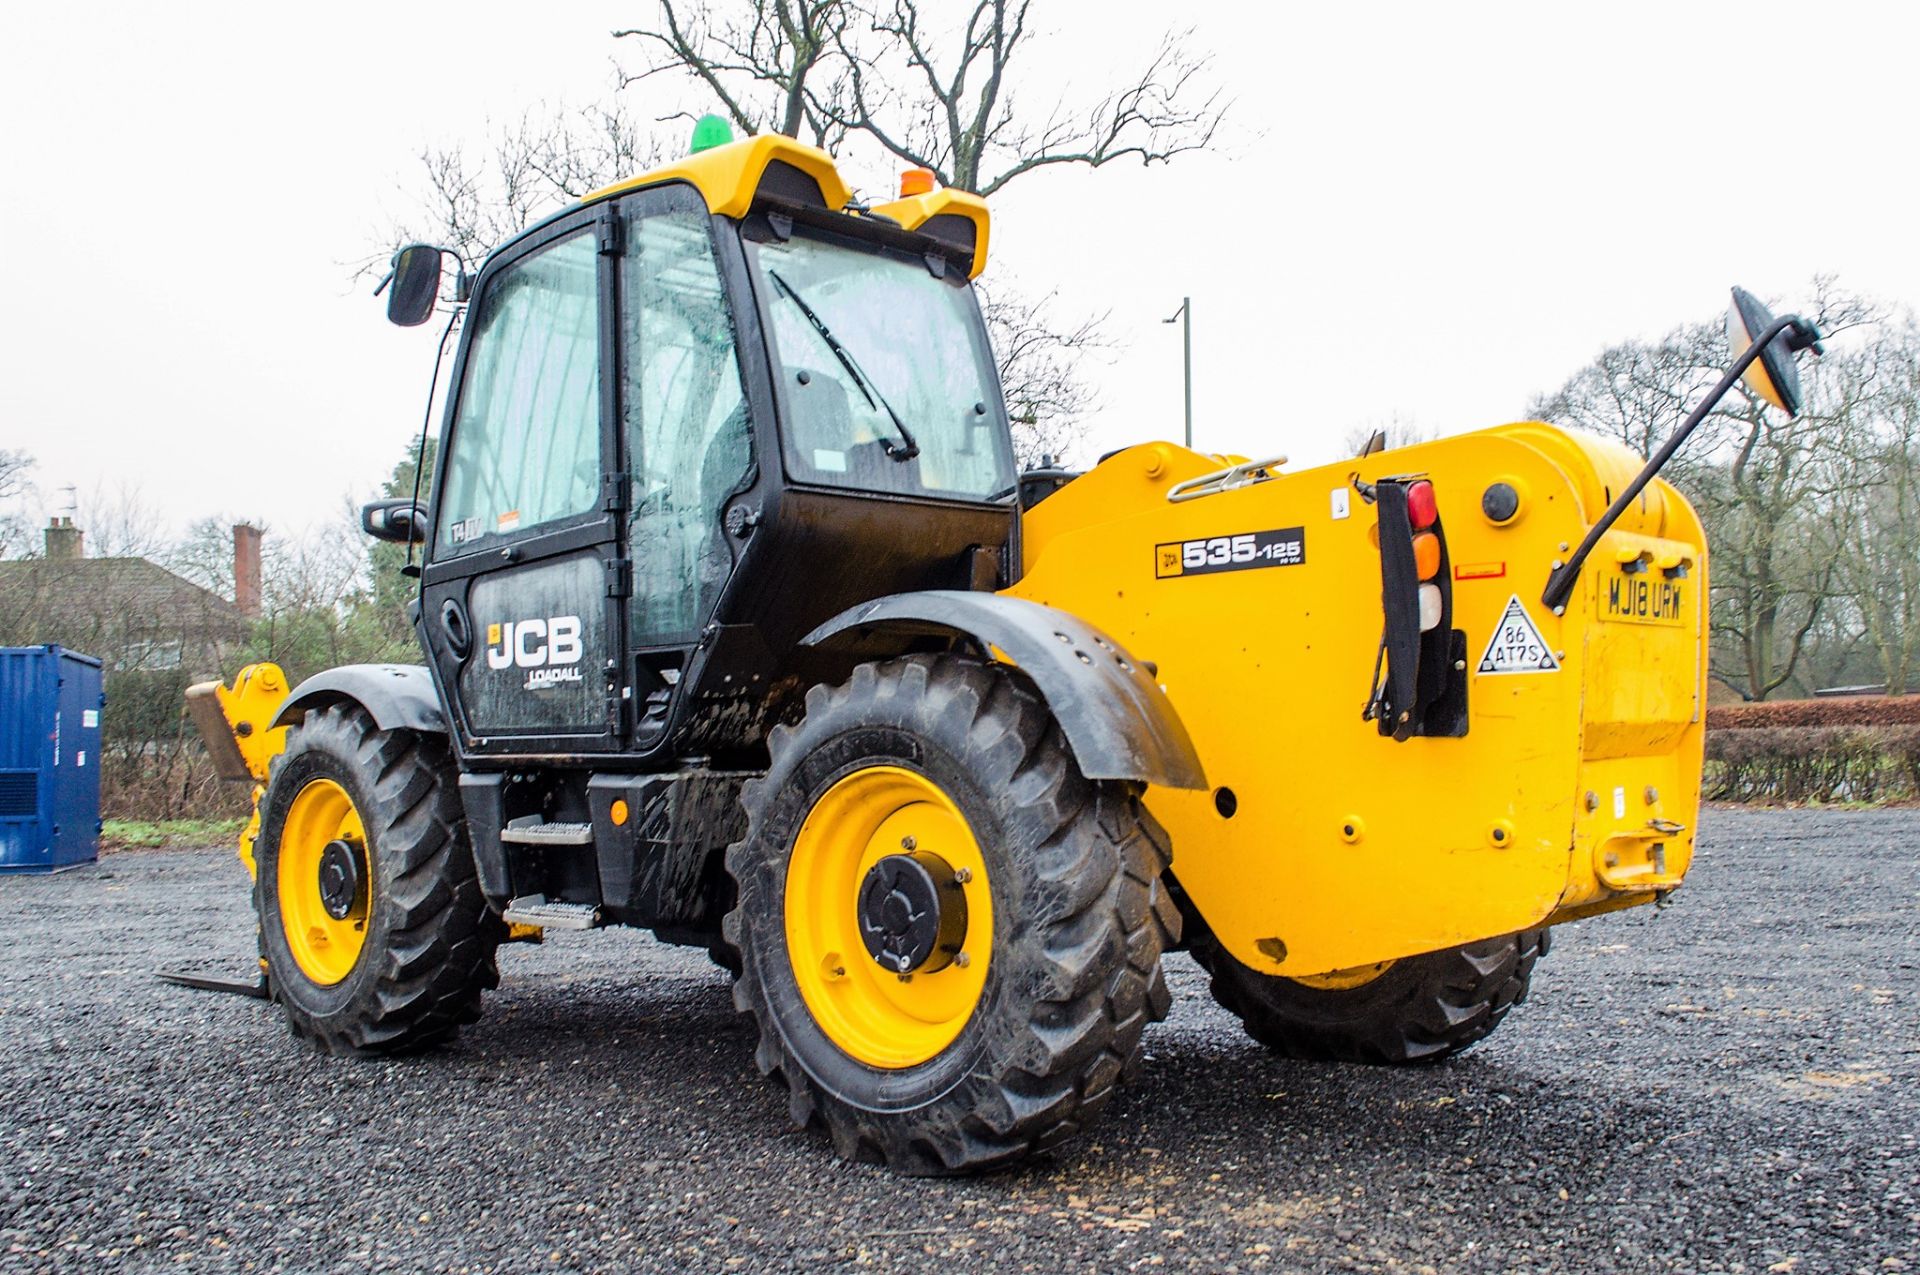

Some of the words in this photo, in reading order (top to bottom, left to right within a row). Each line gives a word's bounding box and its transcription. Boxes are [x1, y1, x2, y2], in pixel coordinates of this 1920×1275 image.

[1609, 577, 1648, 616] MJ18
[1652, 582, 1681, 619] URW
[487, 615, 583, 670] JCB
[1506, 626, 1525, 643] 86
[1496, 645, 1538, 663] AT7S
[529, 667, 583, 683] LOADALL
